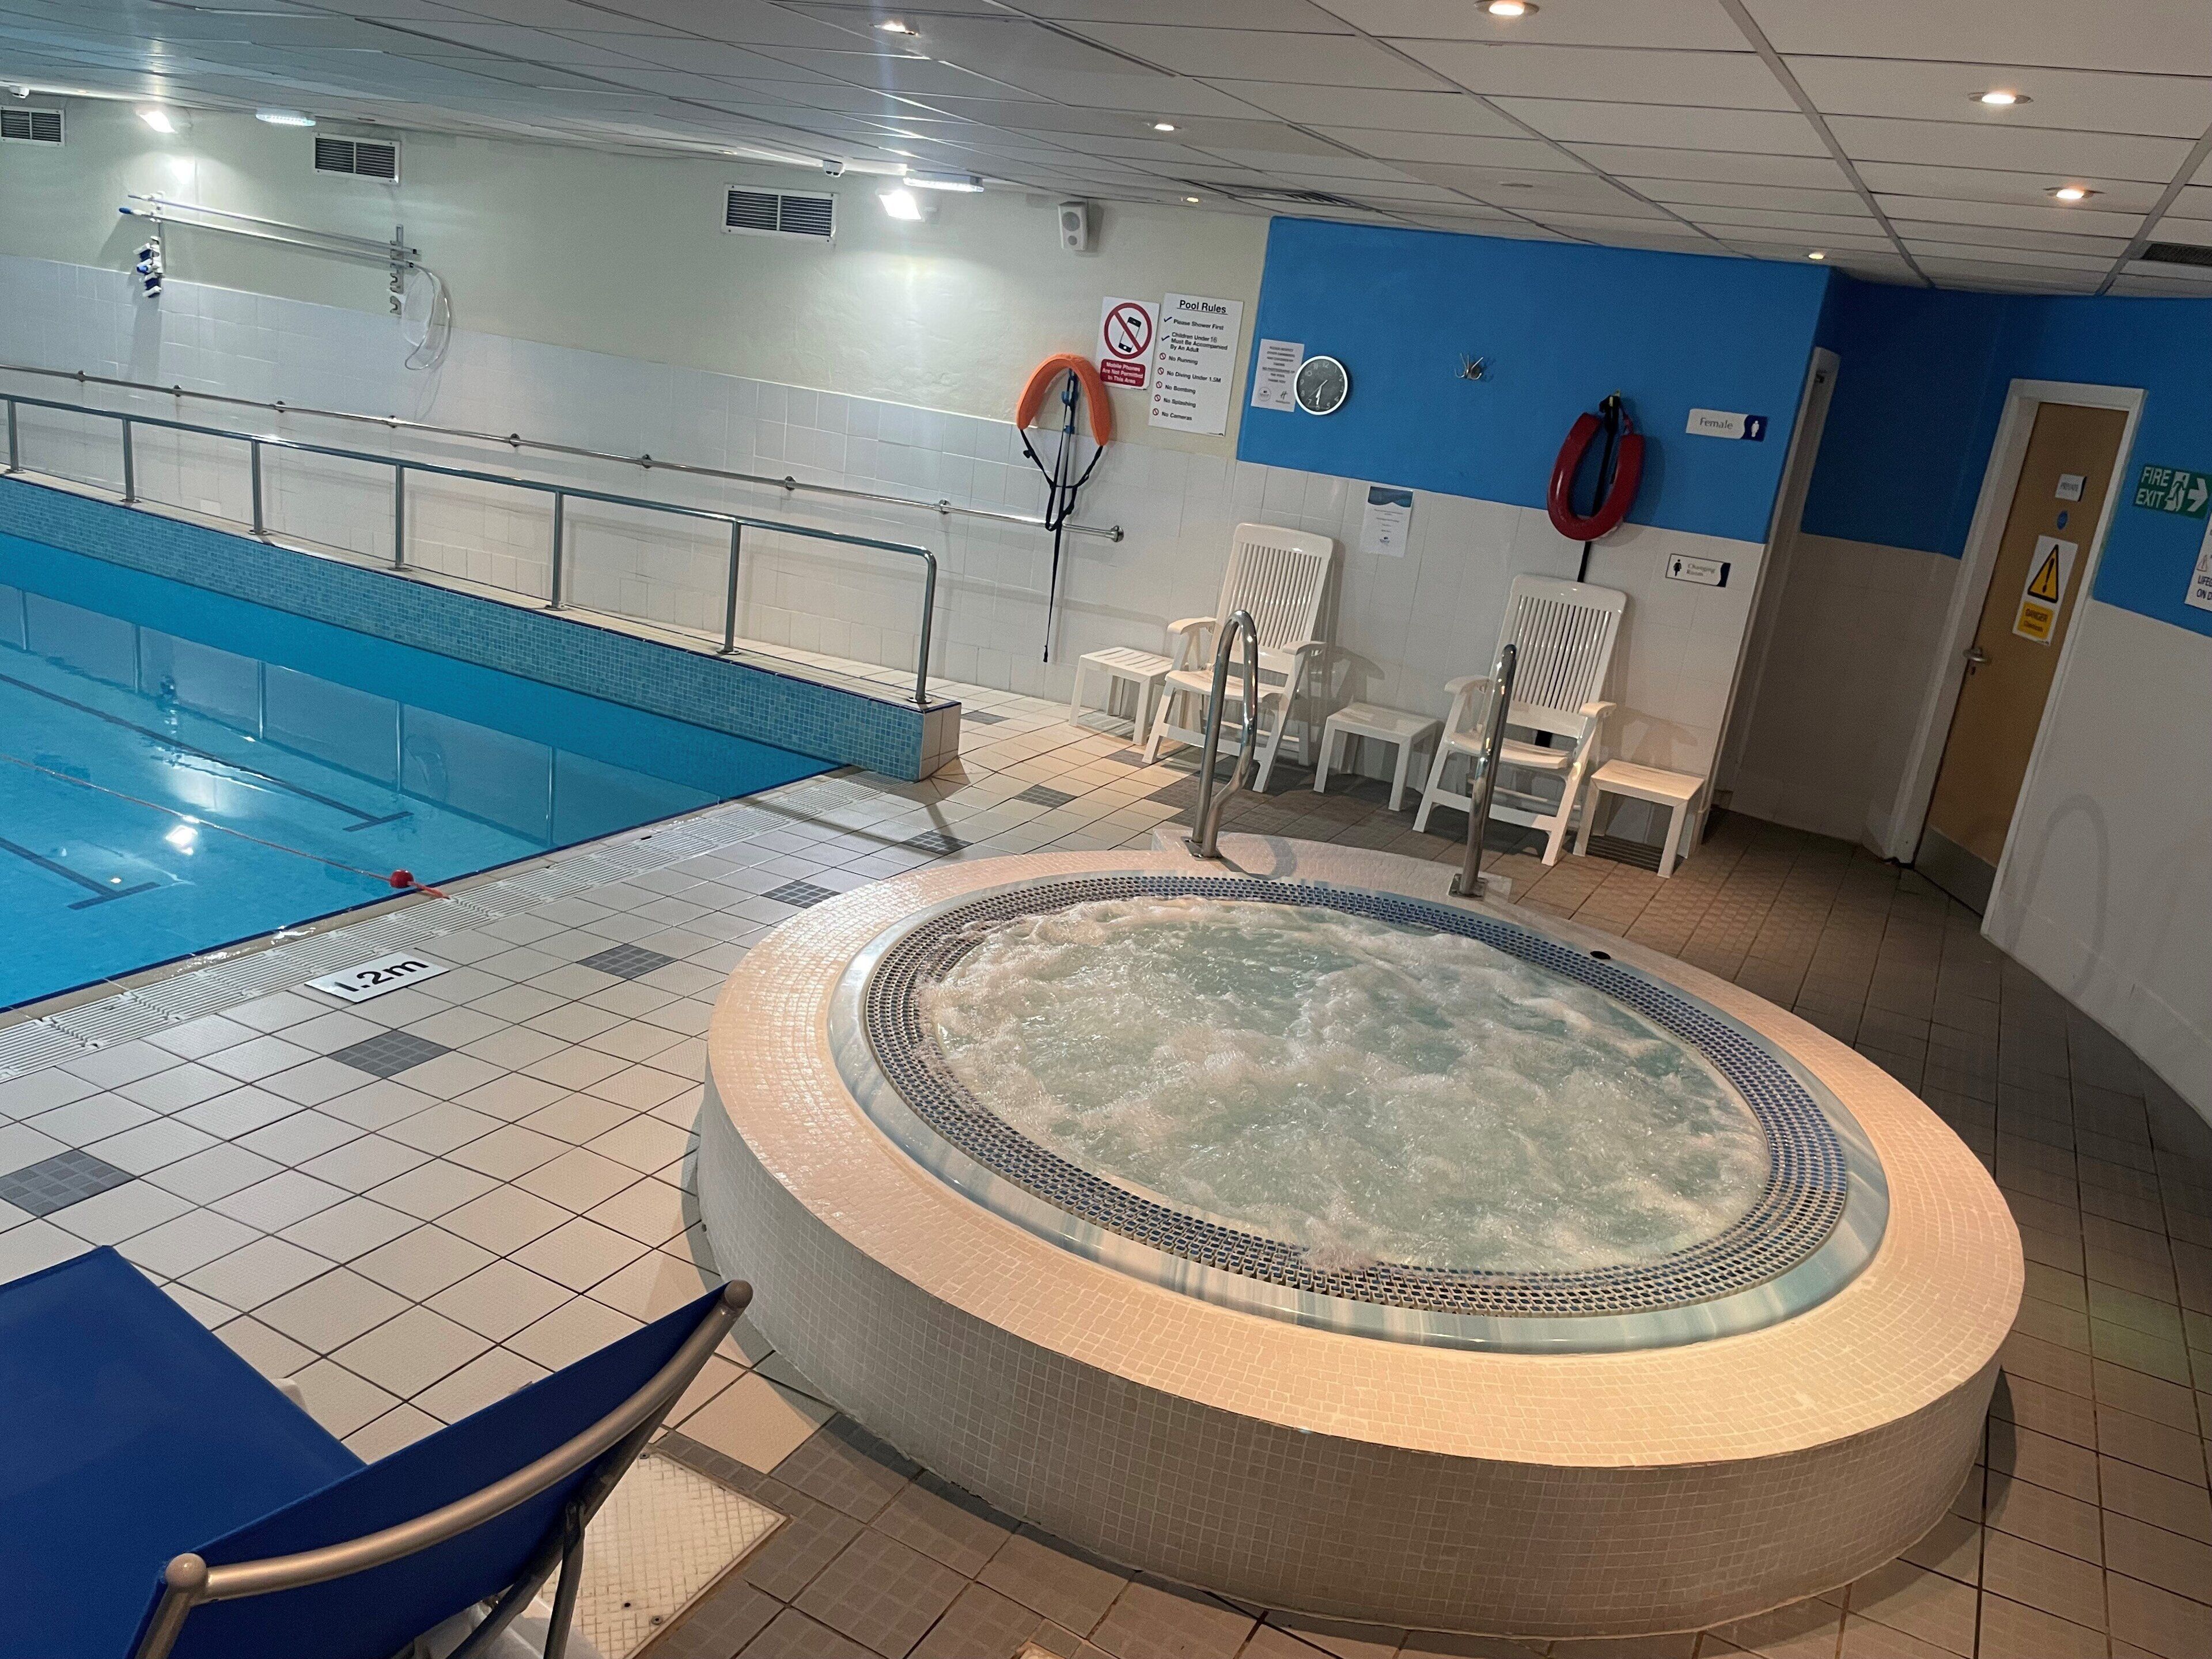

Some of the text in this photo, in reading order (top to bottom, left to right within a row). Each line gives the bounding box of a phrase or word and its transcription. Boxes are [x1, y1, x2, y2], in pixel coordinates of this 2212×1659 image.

[1179, 300, 1226, 313] Pool Rules
[1177, 357, 1198, 365] Running
[1122, 364, 1141, 372] Phones
[1175, 372, 1191, 380] Diving
[1173, 385, 1196, 395] Bombing
[1172, 399, 1196, 408] Splashing
[1170, 412, 1192, 421] Cameras
[1699, 417, 1733, 430] Female
[2141, 466, 2172, 487] FIRE
[2135, 488, 2165, 508] EXIT
[334, 960, 430, 993] 1.2m
